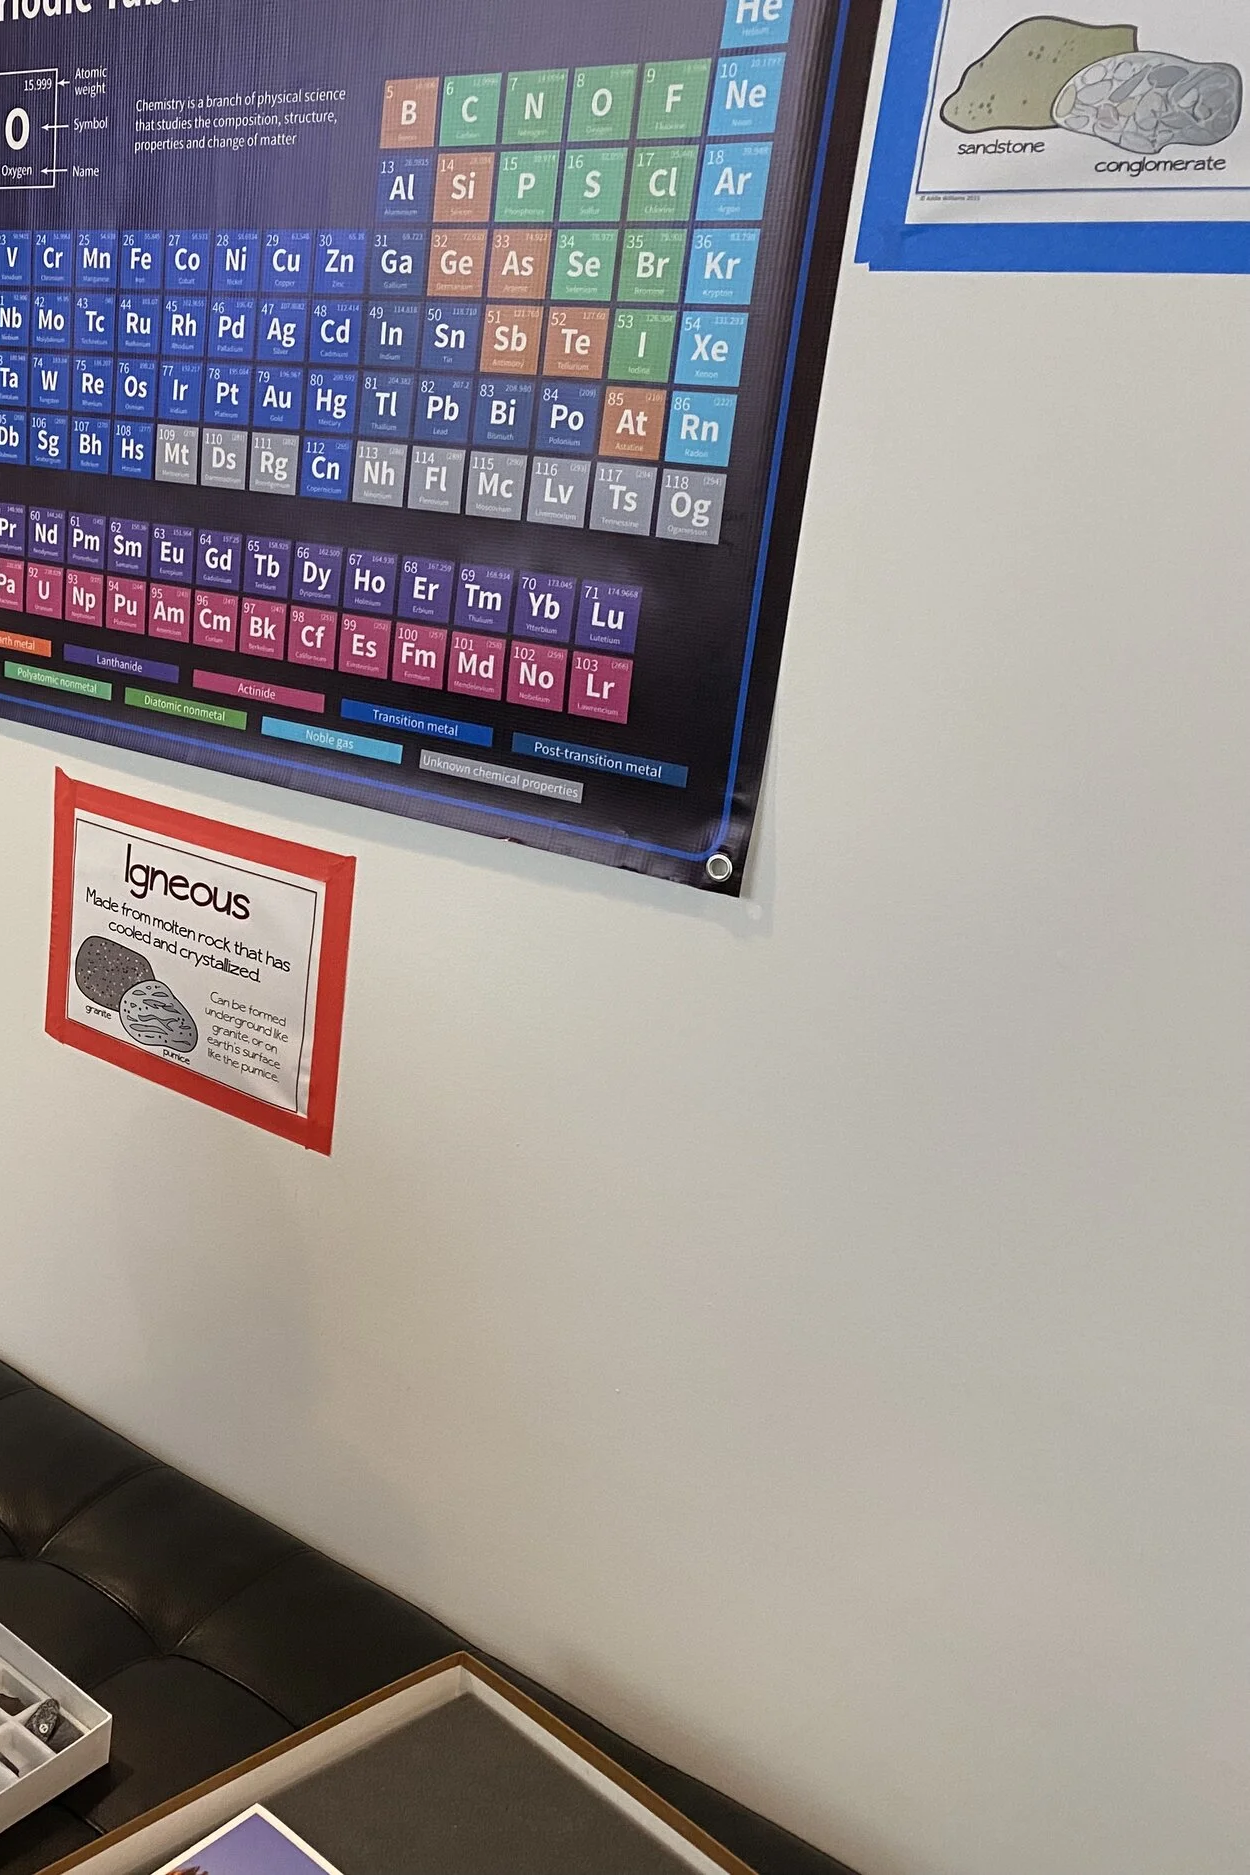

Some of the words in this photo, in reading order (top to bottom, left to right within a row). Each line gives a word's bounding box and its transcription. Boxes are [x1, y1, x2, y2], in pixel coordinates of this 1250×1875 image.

[74, 65, 108, 80] Atomic
[720, 62, 737, 79] 10
[24, 78, 52, 92] 15.999
[74, 82, 106, 98] weight
[446, 81, 454, 95] 6
[725, 79, 767, 110] Ne
[136, 98, 186, 112] Chemistry
[187, 97, 196, 109] is
[197, 98, 204, 108] a
[206, 92, 242, 108] branch
[244, 91, 256, 106] of
[257, 89, 302, 108] physical
[304, 89, 346, 102] science
[461, 96, 479, 122] C
[5, 107, 30, 150] O
[74, 117, 108, 133] Symbol
[135, 119, 154, 131] that
[156, 116, 192, 130] studies
[194, 115, 211, 128] the
[213, 112, 282, 130] composition,
[284, 110, 338, 125] structure,
[134, 138, 184, 154] properties
[186, 135, 204, 150] and
[207, 134, 244, 151] change
[247, 132, 258, 146] of
[260, 133, 298, 146] matter
[957, 139, 1046, 156] sandstone
[1, 164, 33, 180] Oxygen
[72, 165, 100, 177] Name
[1094, 155, 1227, 178] conglomerate
[122, 234, 135, 246] 26
[266, 234, 280, 246] 29
[130, 248, 152, 270] Fe
[272, 248, 301, 273] Cu
[703, 251, 741, 281] Kr
[261, 303, 275, 316] 47
[266, 317, 297, 348] Ag
[684, 316, 701, 332] 54
[690, 334, 730, 362] Xe
[257, 371, 271, 384] 79
[420, 381, 435, 394] 82
[262, 385, 292, 409] Au
[426, 396, 460, 422] Pb
[432, 428, 449, 436] Lead
[664, 474, 690, 490] 118
[609, 484, 638, 512] Ts
[670, 490, 712, 528] Og
[38, 580, 50, 600] U
[584, 585, 599, 600] 71
[591, 602, 625, 630] Lu
[13, 636, 36, 651] metal
[589, 633, 621, 646] Lutetium
[96, 654, 143, 673] Lanthanide
[575, 658, 599, 672] 103
[17, 667, 58, 686] Polyatomic
[60, 676, 98, 694] nonmetal
[238, 682, 276, 700] Actinide
[586, 673, 616, 700] Lr
[144, 695, 182, 713] Diatomic
[183, 704, 226, 722] nonmetal
[372, 709, 425, 731] Transition
[427, 720, 459, 737] metal
[306, 730, 335, 746] Noble
[336, 736, 354, 750] gas
[534, 741, 622, 770] Post-transition
[625, 759, 662, 779] metal
[422, 754, 471, 778] Unknown
[473, 766, 520, 787] chemical
[522, 776, 579, 798] properties
[124, 843, 251, 920] Igneous
[86, 886, 119, 913] Made
[122, 902, 151, 925] from
[153, 917, 196, 942] molten
[198, 933, 231, 952] rock
[234, 940, 263, 963] that
[265, 951, 291, 973] has
[108, 920, 151, 945] cooled
[153, 936, 178, 955] and
[179, 946, 262, 984] crystallized.
[85, 1004, 112, 1020] granite
[210, 991, 231, 1009] Can
[232, 997, 246, 1013] be
[248, 1004, 287, 1028] formed
[205, 1006, 273, 1038] underground
[274, 1027, 289, 1044] like
[212, 1024, 250, 1046] granite,
[252, 1036, 264, 1048] or
[265, 1042, 278, 1054] on
[163, 1048, 190, 1066] pumice
[207, 1035, 240, 1056] earth's
[242, 1048, 282, 1070] surface
[207, 1048, 222, 1063] like
[223, 1054, 240, 1070] the
[240, 1061, 280, 1084] pumice.
